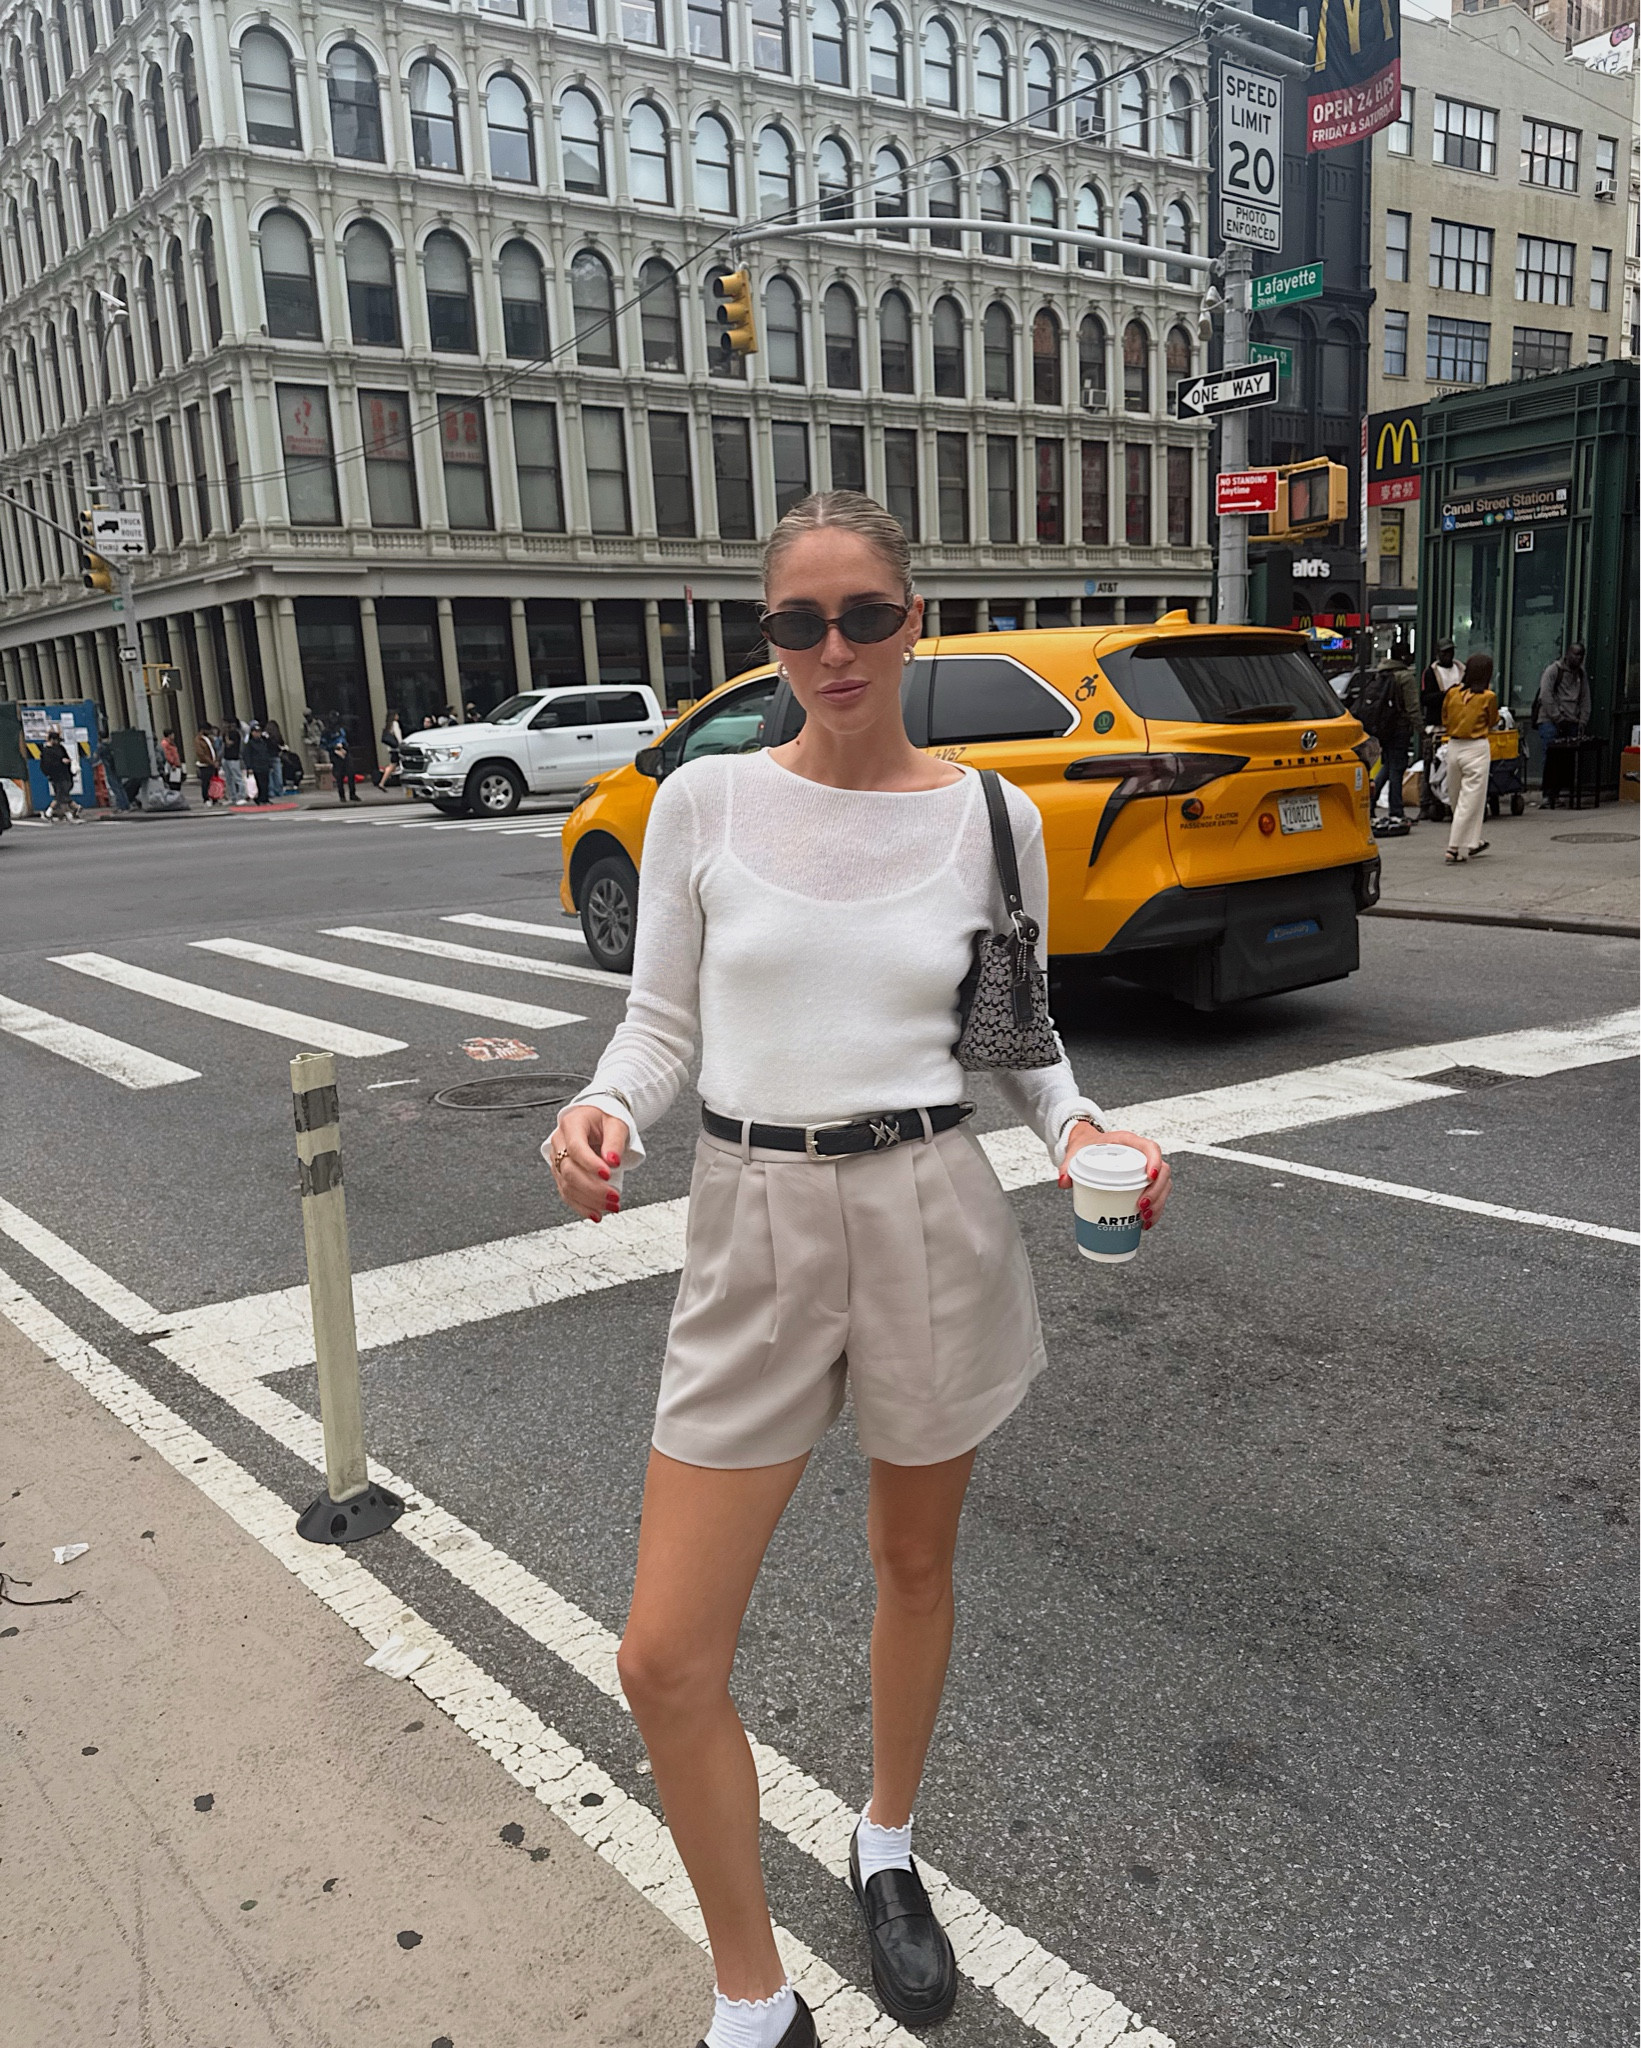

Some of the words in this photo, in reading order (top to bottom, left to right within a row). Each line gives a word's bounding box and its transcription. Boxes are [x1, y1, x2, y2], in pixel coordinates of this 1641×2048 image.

[1226, 75, 1277, 109] SPEED
[1313, 97, 1353, 124] OPEN
[1357, 88, 1373, 112] 24
[1375, 72, 1394, 100] HRS
[1231, 105, 1271, 135] LIMIT
[1312, 123, 1348, 143] FRIDAY
[1349, 121, 1357, 135] &
[1358, 97, 1394, 132] SATURDAY
[1228, 140, 1275, 195] 20
[1236, 206, 1267, 226] PHOTO
[1226, 219, 1276, 242] ENFORCED
[1257, 269, 1316, 297] Lafayette
[1257, 295, 1277, 307] Street
[1280, 351, 1287, 365] St
[1192, 386, 1219, 405] ONE
[1233, 376, 1264, 397] WAY
[1220, 477, 1231, 486] NO
[1232, 475, 1268, 486] STANDING
[1220, 486, 1250, 497] Anytime
[1442, 501, 1474, 516] Canal
[1476, 497, 1510, 512] Street
[1513, 491, 1554, 507] Station
[120, 517, 141, 526] TRUCK
[1514, 514, 1533, 522] across
[1534, 510, 1560, 520] Lafayette
[1560, 508, 1567, 516] St
[1455, 520, 1484, 529] Downtown
[121, 529, 142, 537] ROUTE
[1292, 559, 1330, 578] ald's
[1097, 582, 1118, 593] AT&T
[1273, 754, 1343, 767] SIENNA
[1214, 812, 1239, 820] CAUTION
[1179, 820, 1217, 829] PASSENGER
[1217, 819, 1238, 827] EXITING
